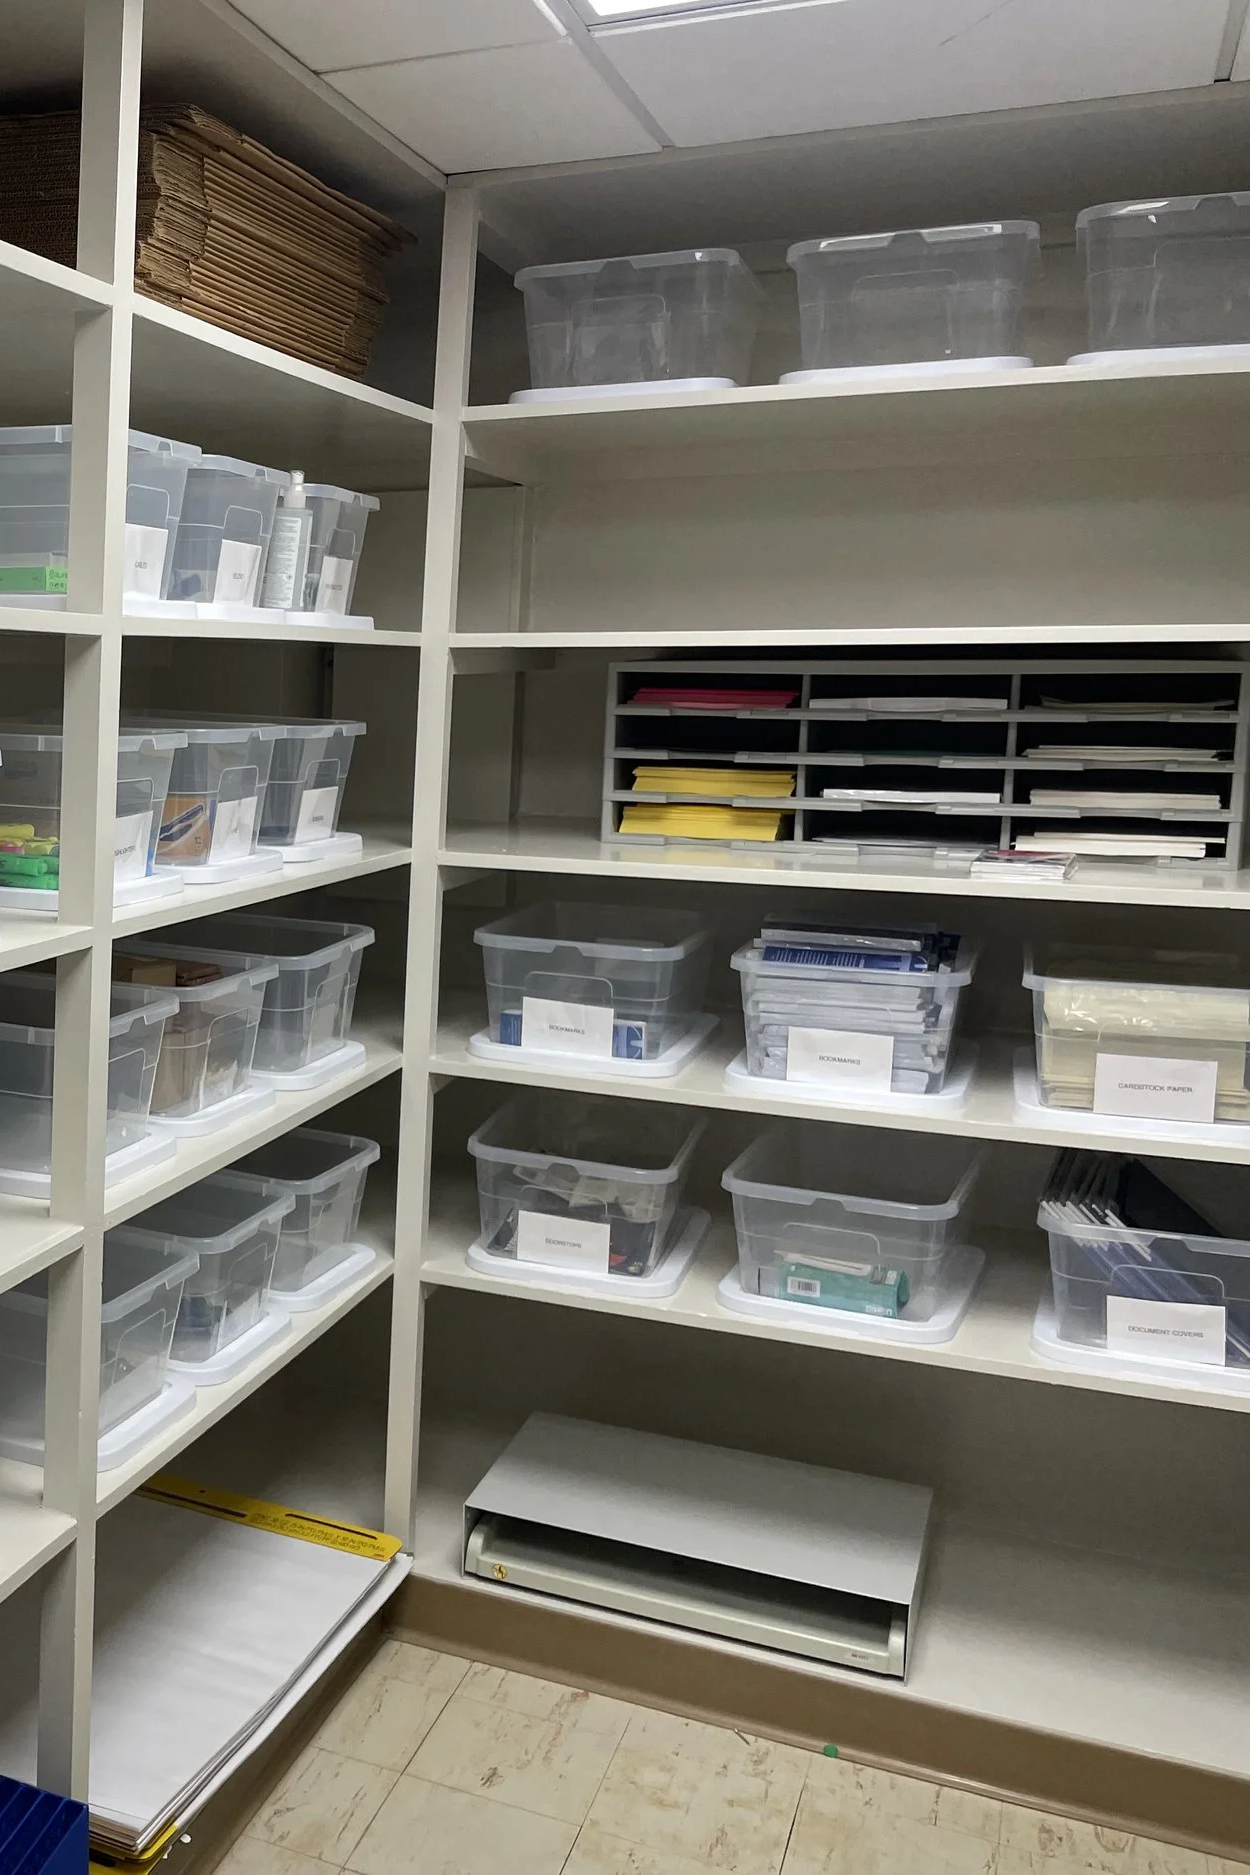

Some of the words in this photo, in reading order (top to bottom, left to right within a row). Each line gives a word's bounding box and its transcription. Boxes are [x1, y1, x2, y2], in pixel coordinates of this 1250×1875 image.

[818, 1054, 861, 1066] BOOKMARKS
[1117, 1082, 1165, 1092] CARDSTOCK
[1128, 1325, 1171, 1335] DOCUMENT
[1171, 1330, 1204, 1338] COVERS
